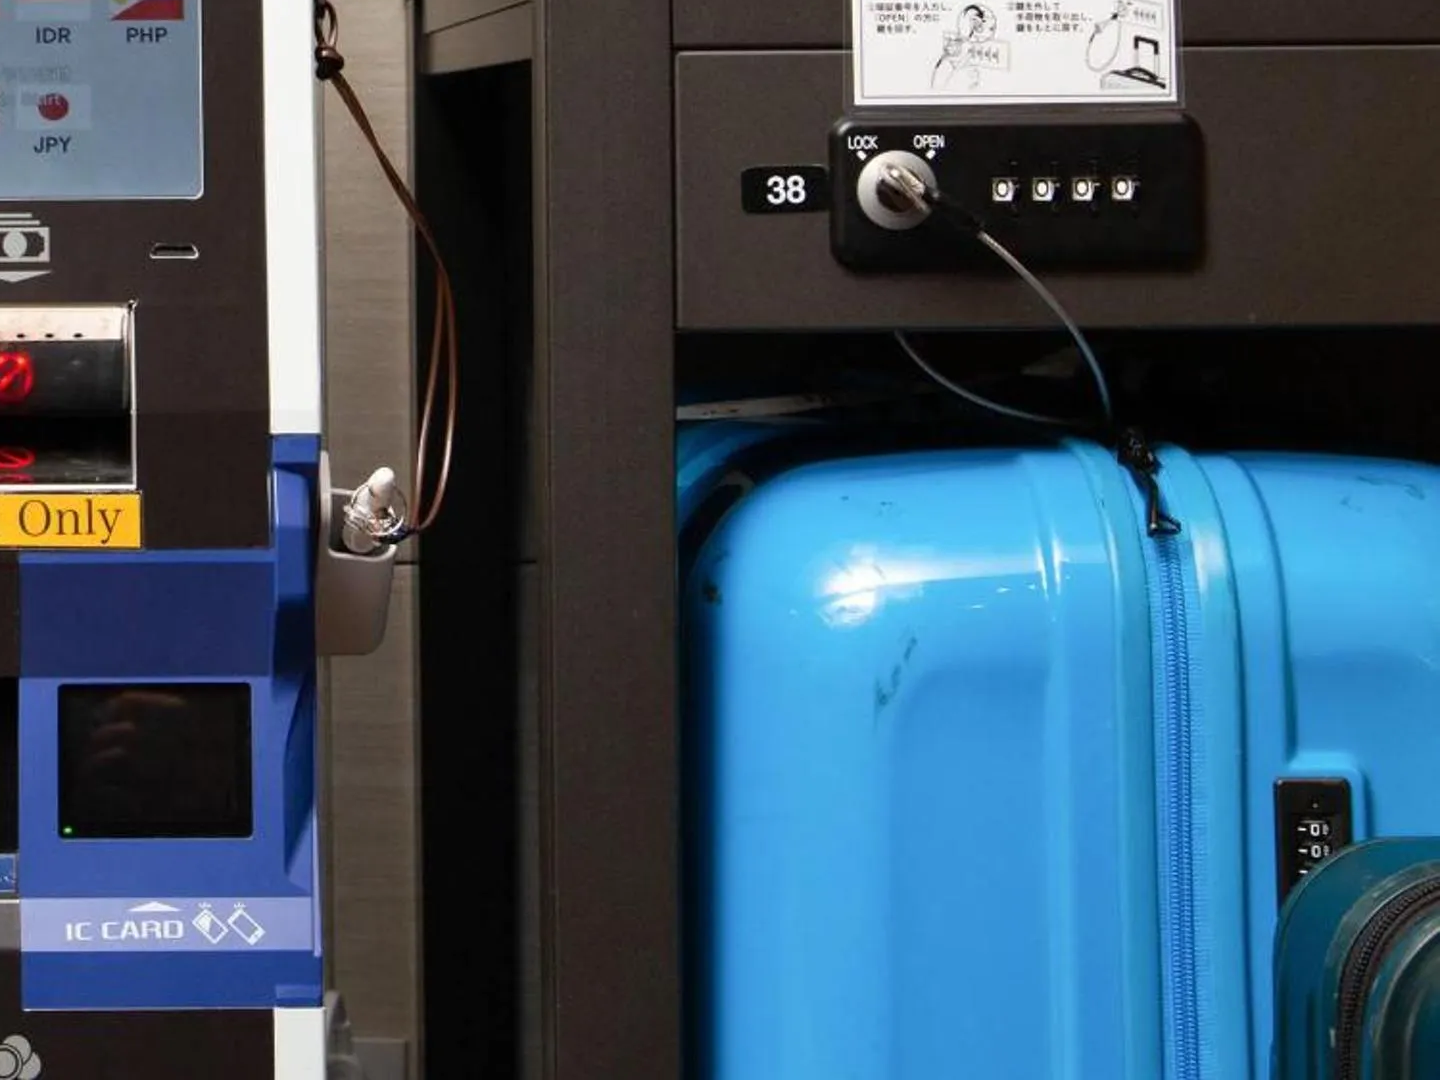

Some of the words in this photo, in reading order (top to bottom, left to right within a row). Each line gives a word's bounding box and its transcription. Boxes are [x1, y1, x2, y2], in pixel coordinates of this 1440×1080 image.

[35, 27, 72, 44] IDR
[126, 27, 168, 43] PHP
[34, 136, 71, 154] JPY
[847, 135, 878, 150] LOCK
[913, 134, 944, 149] OPEN
[766, 174, 806, 205] 38
[18, 498, 123, 544] Only
[65, 921, 92, 942] IC
[101, 919, 185, 941] CARD
